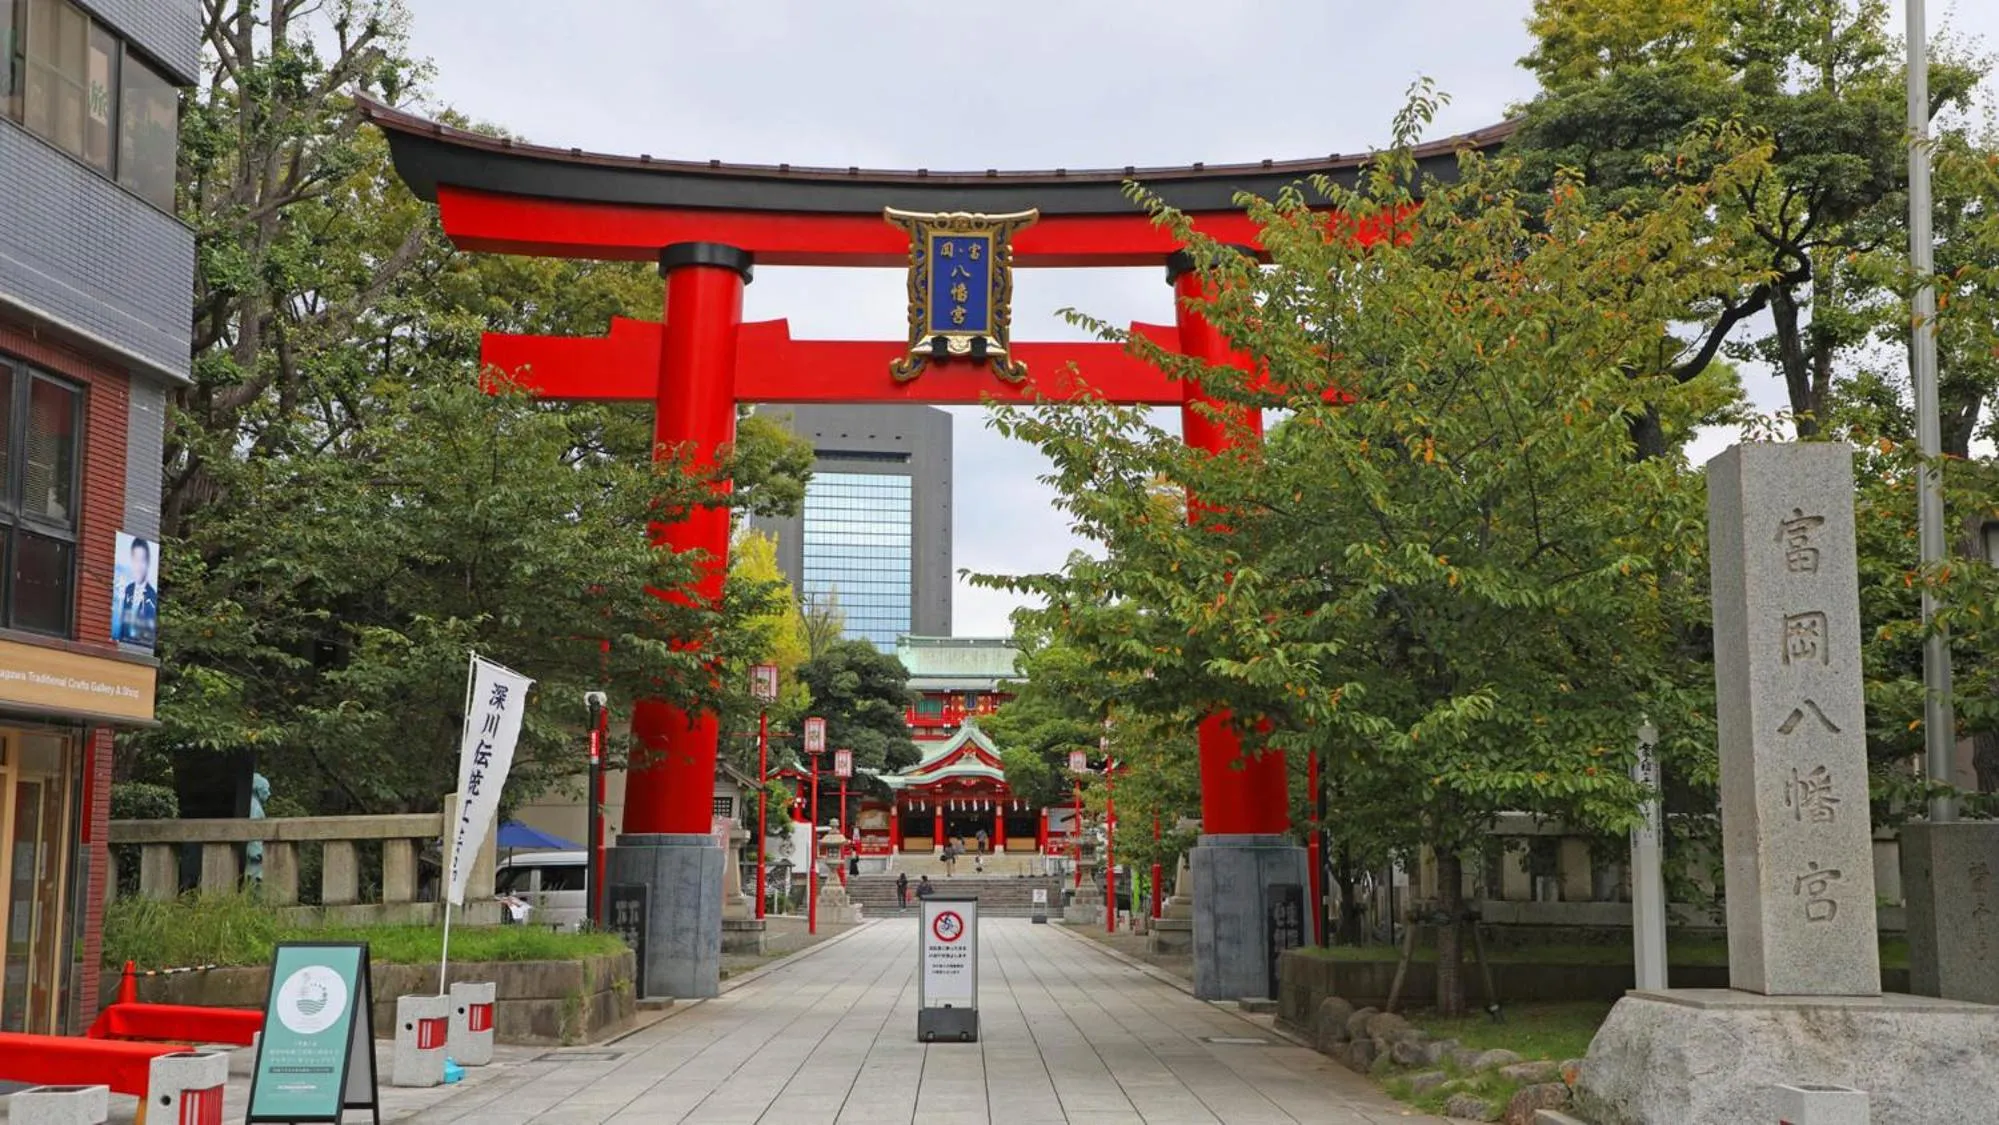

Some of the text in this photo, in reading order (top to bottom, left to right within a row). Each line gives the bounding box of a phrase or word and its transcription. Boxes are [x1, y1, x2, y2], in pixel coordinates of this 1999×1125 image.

[28, 671, 67, 687] Traditional
[1774, 507, 1842, 924] 富岡八幡宮
